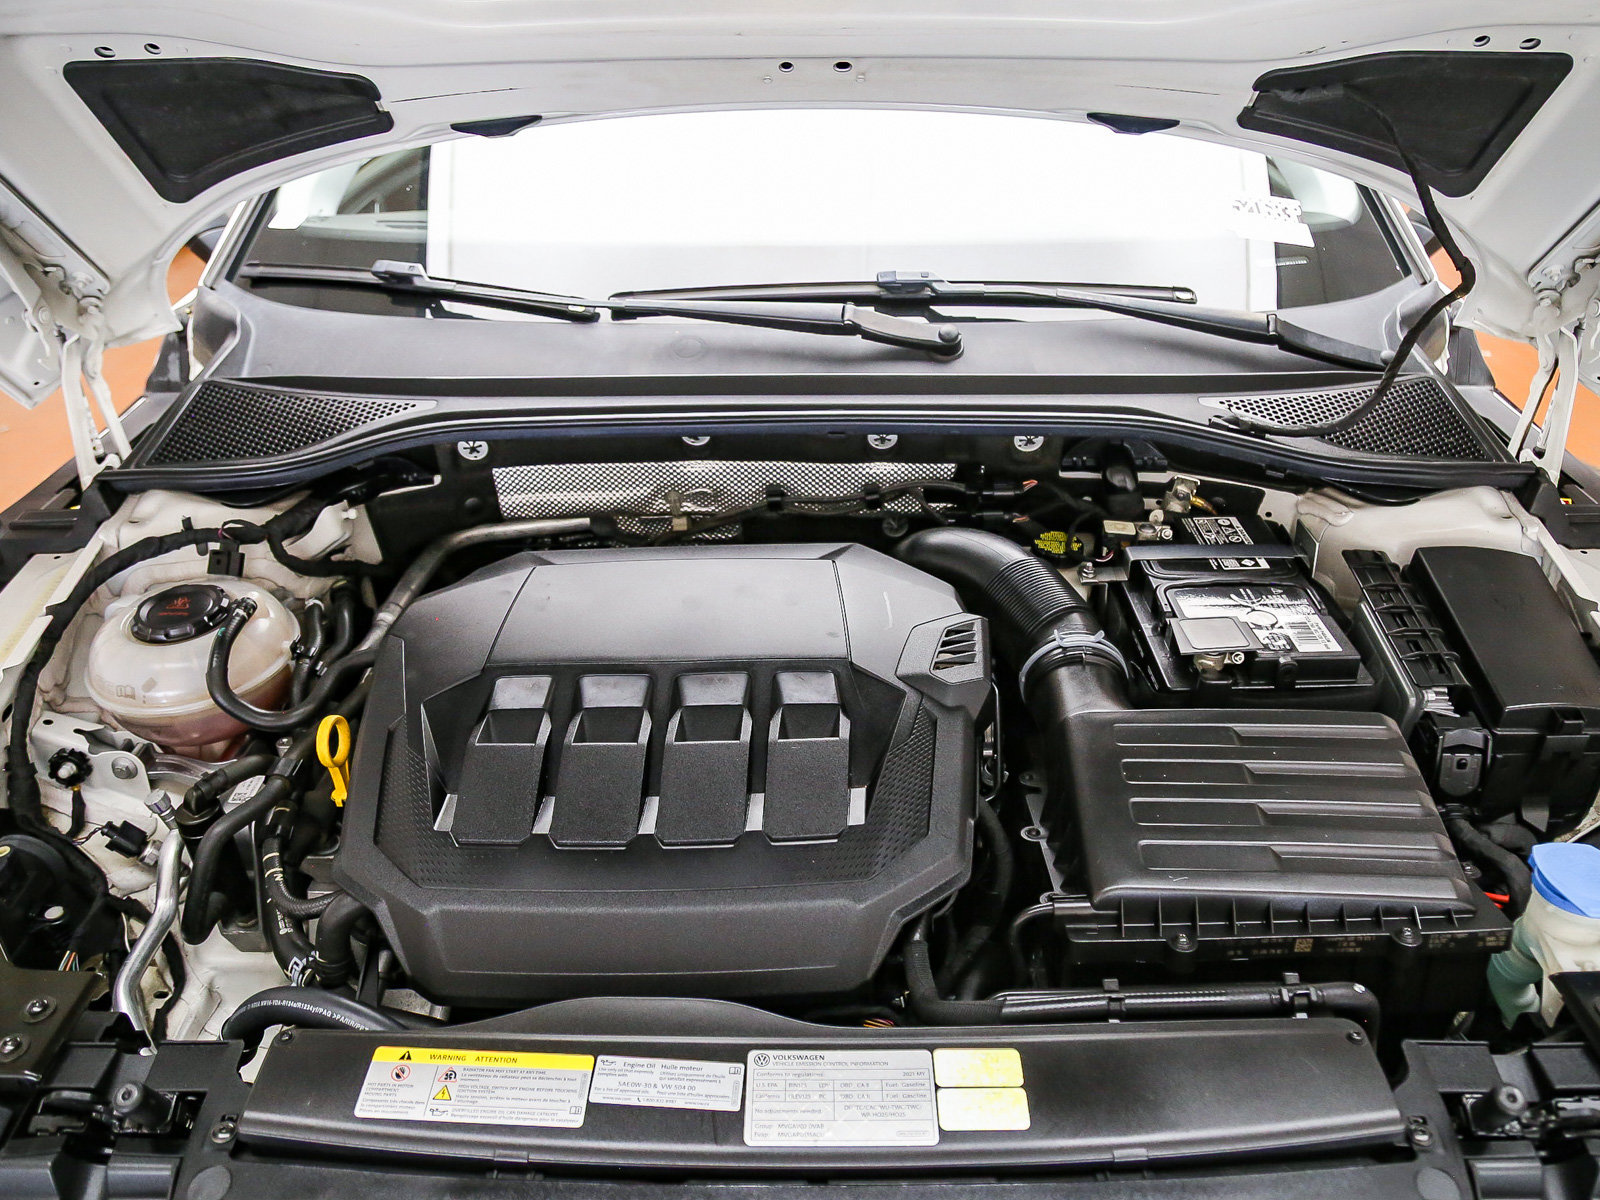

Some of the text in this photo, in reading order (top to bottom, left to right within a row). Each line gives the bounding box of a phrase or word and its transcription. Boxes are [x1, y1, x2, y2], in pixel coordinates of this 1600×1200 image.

[429, 1054, 466, 1062] WARNING
[475, 1056, 518, 1064] ATTENTION
[623, 1061, 645, 1069] Engine
